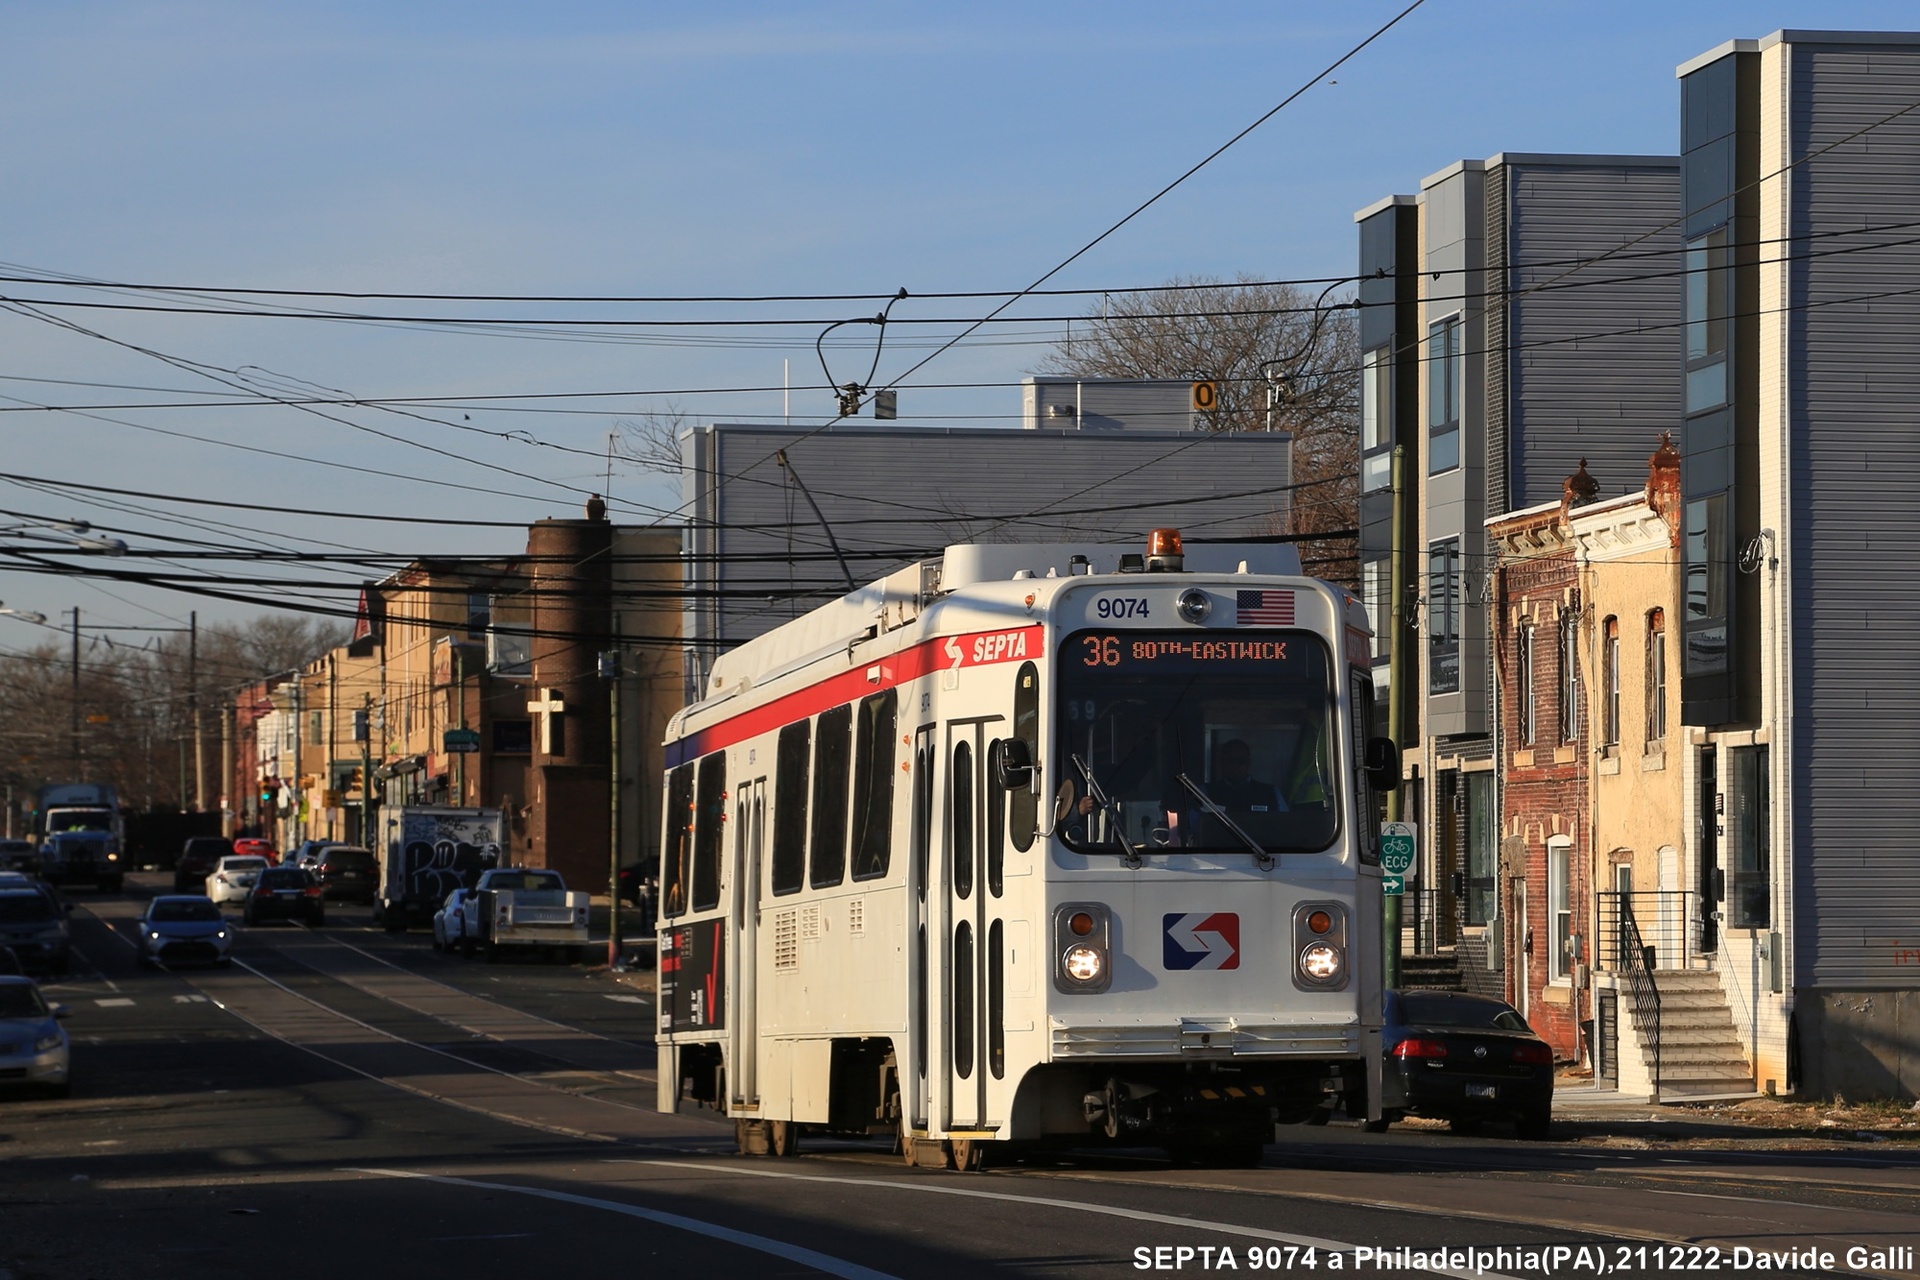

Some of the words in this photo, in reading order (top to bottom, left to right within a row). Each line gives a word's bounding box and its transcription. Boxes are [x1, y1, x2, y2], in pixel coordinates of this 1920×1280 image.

[1096, 598, 1149, 618] 9074
[973, 631, 1026, 662] SEPTA
[1083, 636, 1120, 666] 36
[1132, 641, 1287, 660] 80TH-EASTWICK
[1385, 856, 1408, 868] ECG
